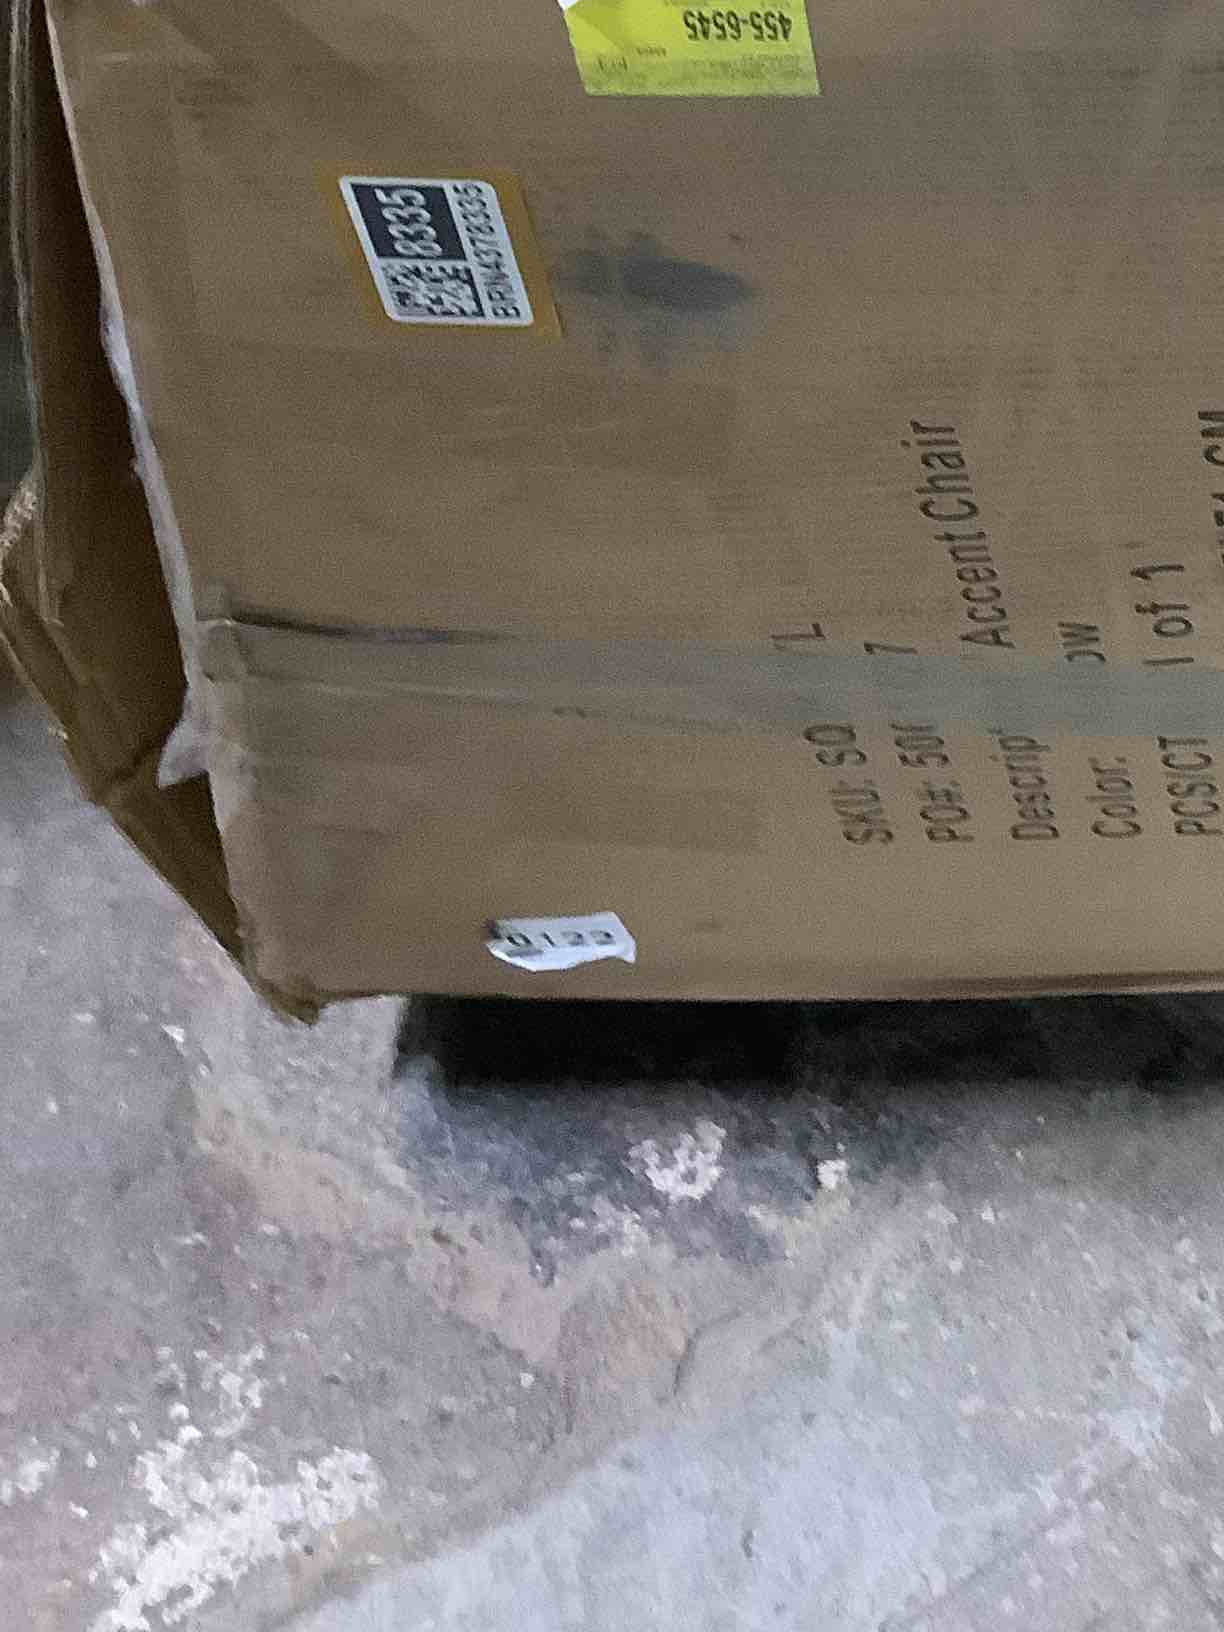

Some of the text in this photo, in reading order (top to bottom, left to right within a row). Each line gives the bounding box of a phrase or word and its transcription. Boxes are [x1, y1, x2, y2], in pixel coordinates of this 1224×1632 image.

[682, 9, 794, 43] 455-6545
[374, 186, 444, 259] 8335
[901, 419, 981, 523] Chair
[935, 530, 1016, 650] Accent
[1129, 564, 1185, 581] 1
[1134, 600, 1195, 638] of
[829, 779, 894, 845] SKU:
[917, 779, 975, 843] PO#:
